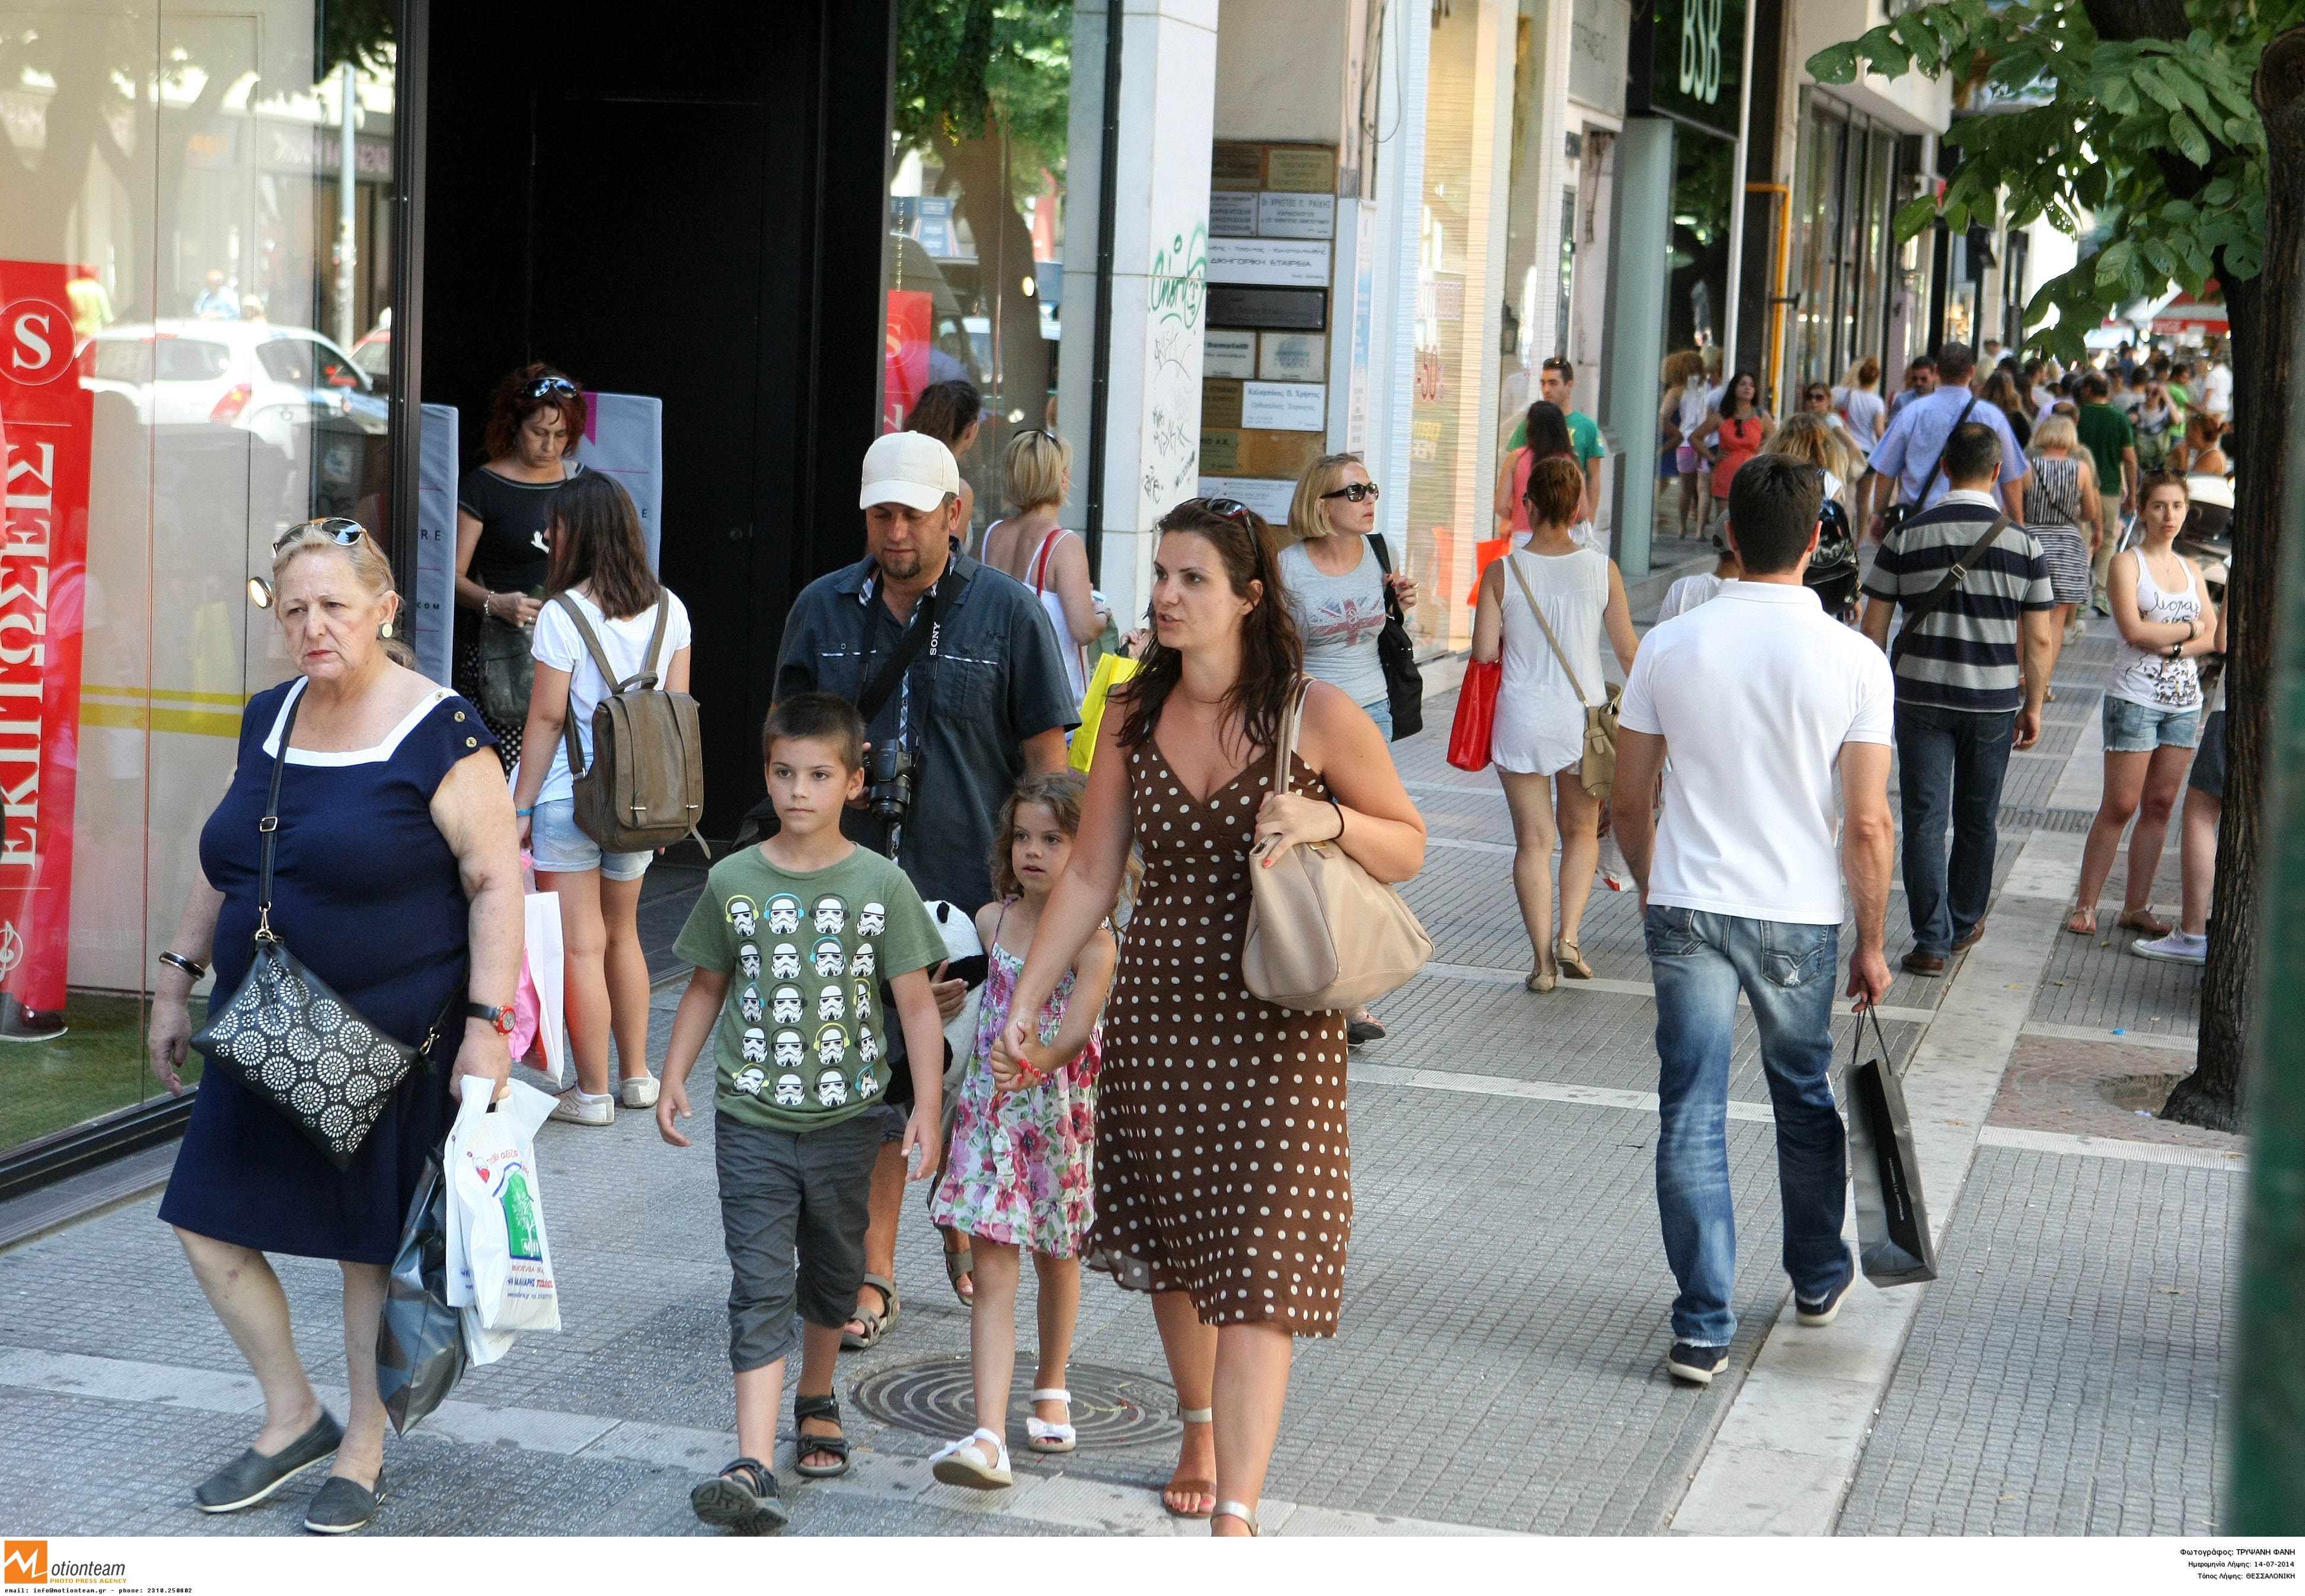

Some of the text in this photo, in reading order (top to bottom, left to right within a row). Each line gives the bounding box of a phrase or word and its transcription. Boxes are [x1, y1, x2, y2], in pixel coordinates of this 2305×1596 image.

[13, 313, 52, 369] S
[0, 442, 55, 871] ΕΚΠΤΩΣΕΙΣ
[930, 621, 941, 656] SONY
